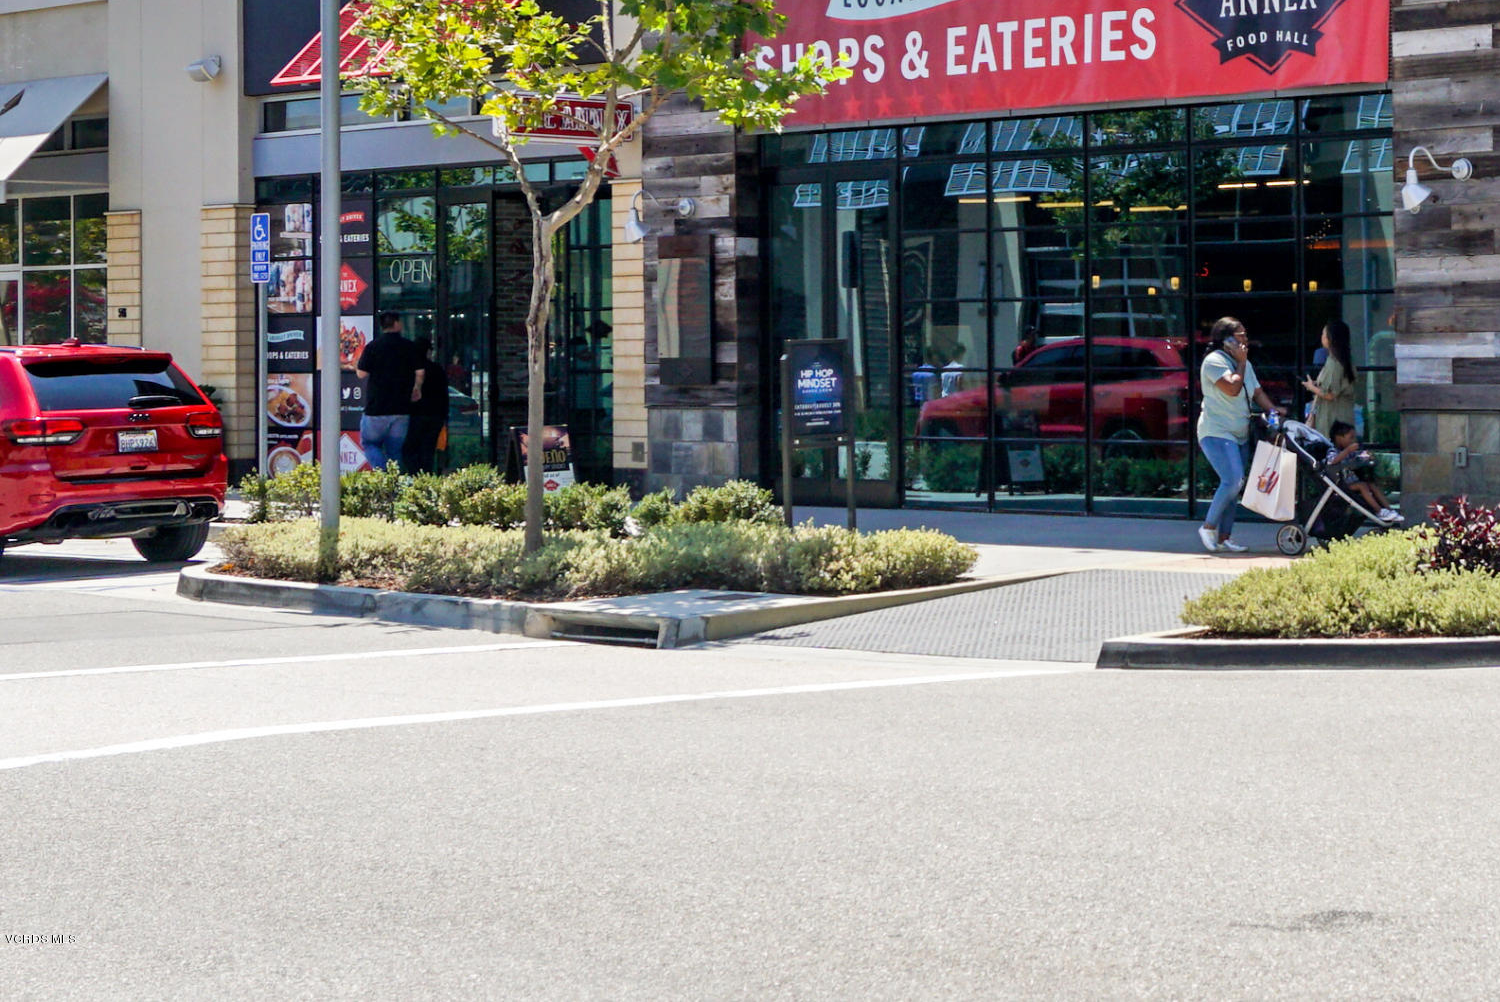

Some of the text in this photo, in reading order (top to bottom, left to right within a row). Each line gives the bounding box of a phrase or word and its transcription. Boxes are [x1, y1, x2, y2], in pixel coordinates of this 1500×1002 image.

[1226, 30, 1309, 51] FOOD HALL
[755, 8, 1157, 93] SHOPS & EATERIES
[344, 233, 370, 243] EATERIES
[389, 259, 433, 284] OPEN
[285, 351, 309, 359] EATERIES
[800, 368, 834, 378] HIP HOP
[798, 377, 838, 389] MINDSET
